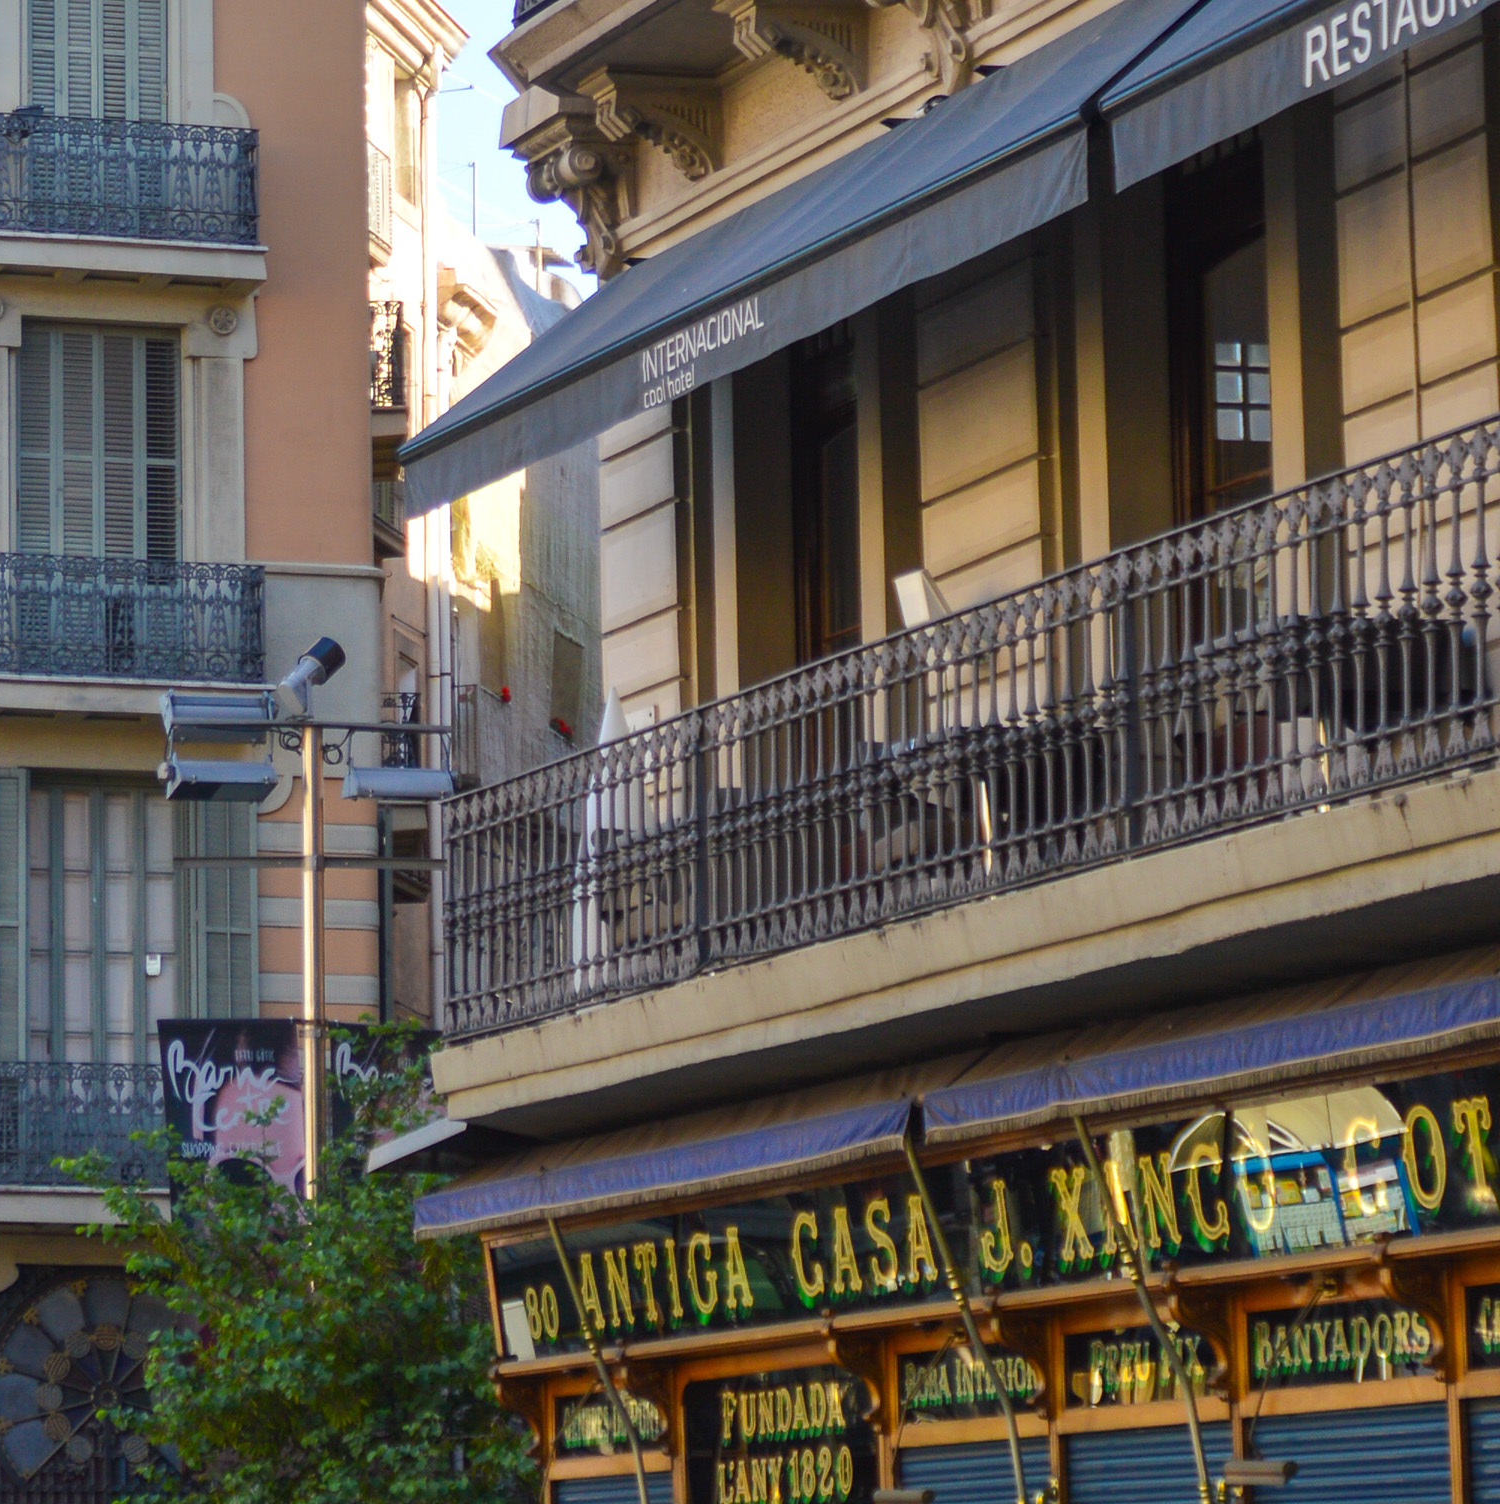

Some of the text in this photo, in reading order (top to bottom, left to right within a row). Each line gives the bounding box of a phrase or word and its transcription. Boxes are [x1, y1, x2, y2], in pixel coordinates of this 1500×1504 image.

[642, 297, 764, 383] INTERNACIONAL
[643, 363, 694, 408] cool hotel
[525, 1283, 559, 1340] 80
[580, 1227, 754, 1330] ANTIGA
[792, 1195, 938, 1298] CASA
[980, 1180, 1033, 1272] J.
[1254, 1311, 1430, 1370] BANYADORS
[721, 1383, 846, 1440] FUNDADA
[788, 1445, 853, 1499] 1820
